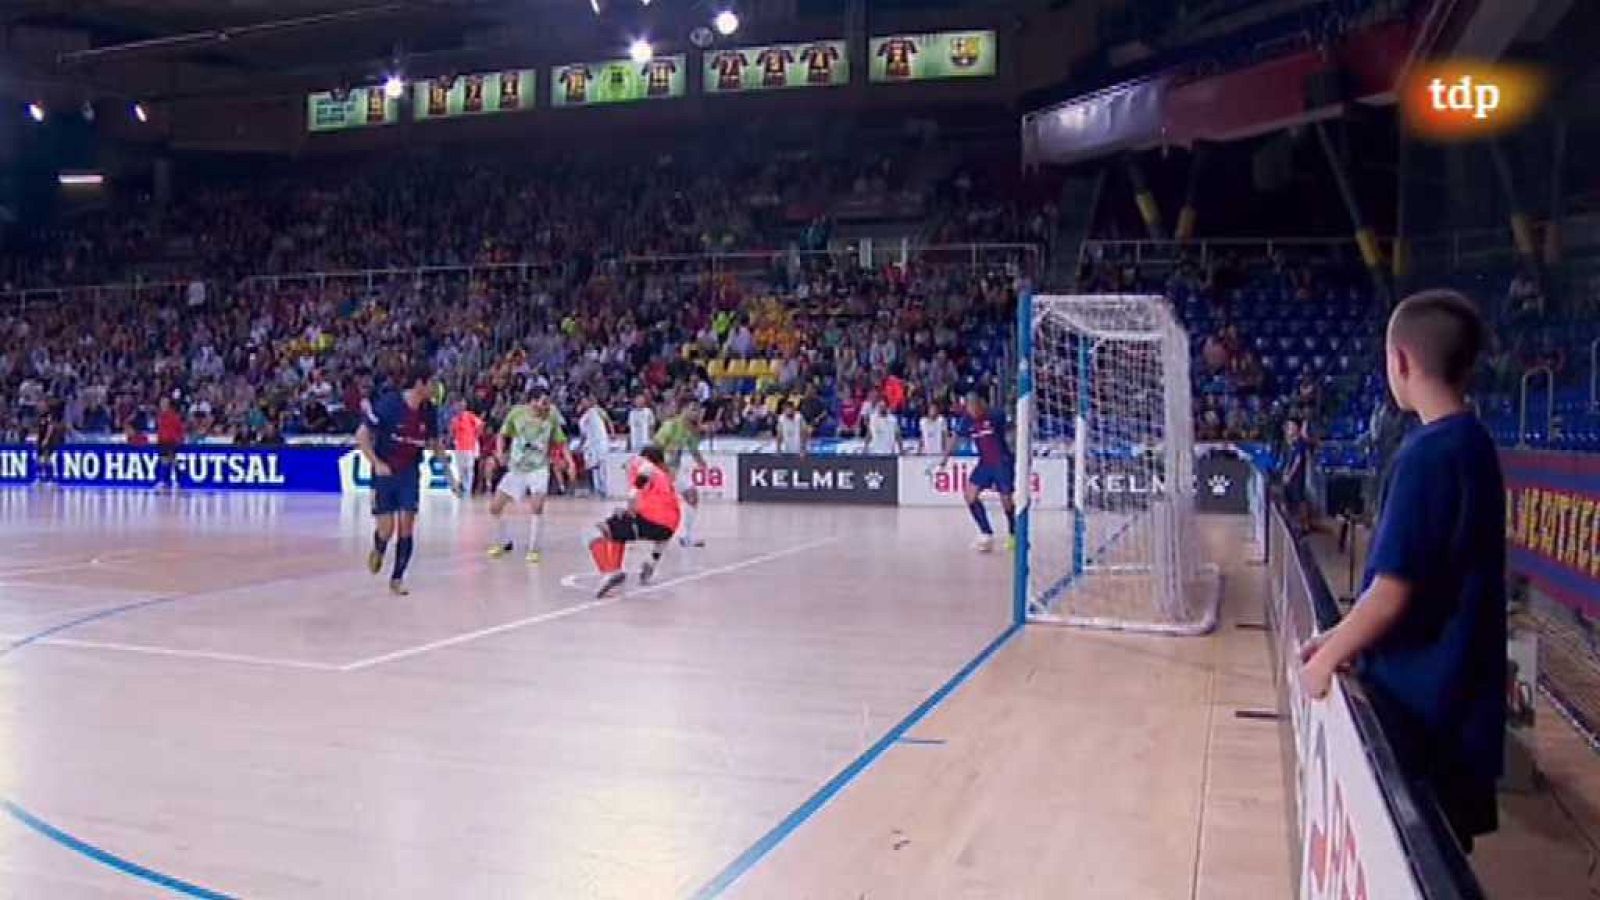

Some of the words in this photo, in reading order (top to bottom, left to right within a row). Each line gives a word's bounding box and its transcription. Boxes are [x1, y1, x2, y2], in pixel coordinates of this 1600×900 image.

[63, 451, 100, 480] NO
[105, 451, 159, 481] HAY
[751, 467, 855, 490] KELME
